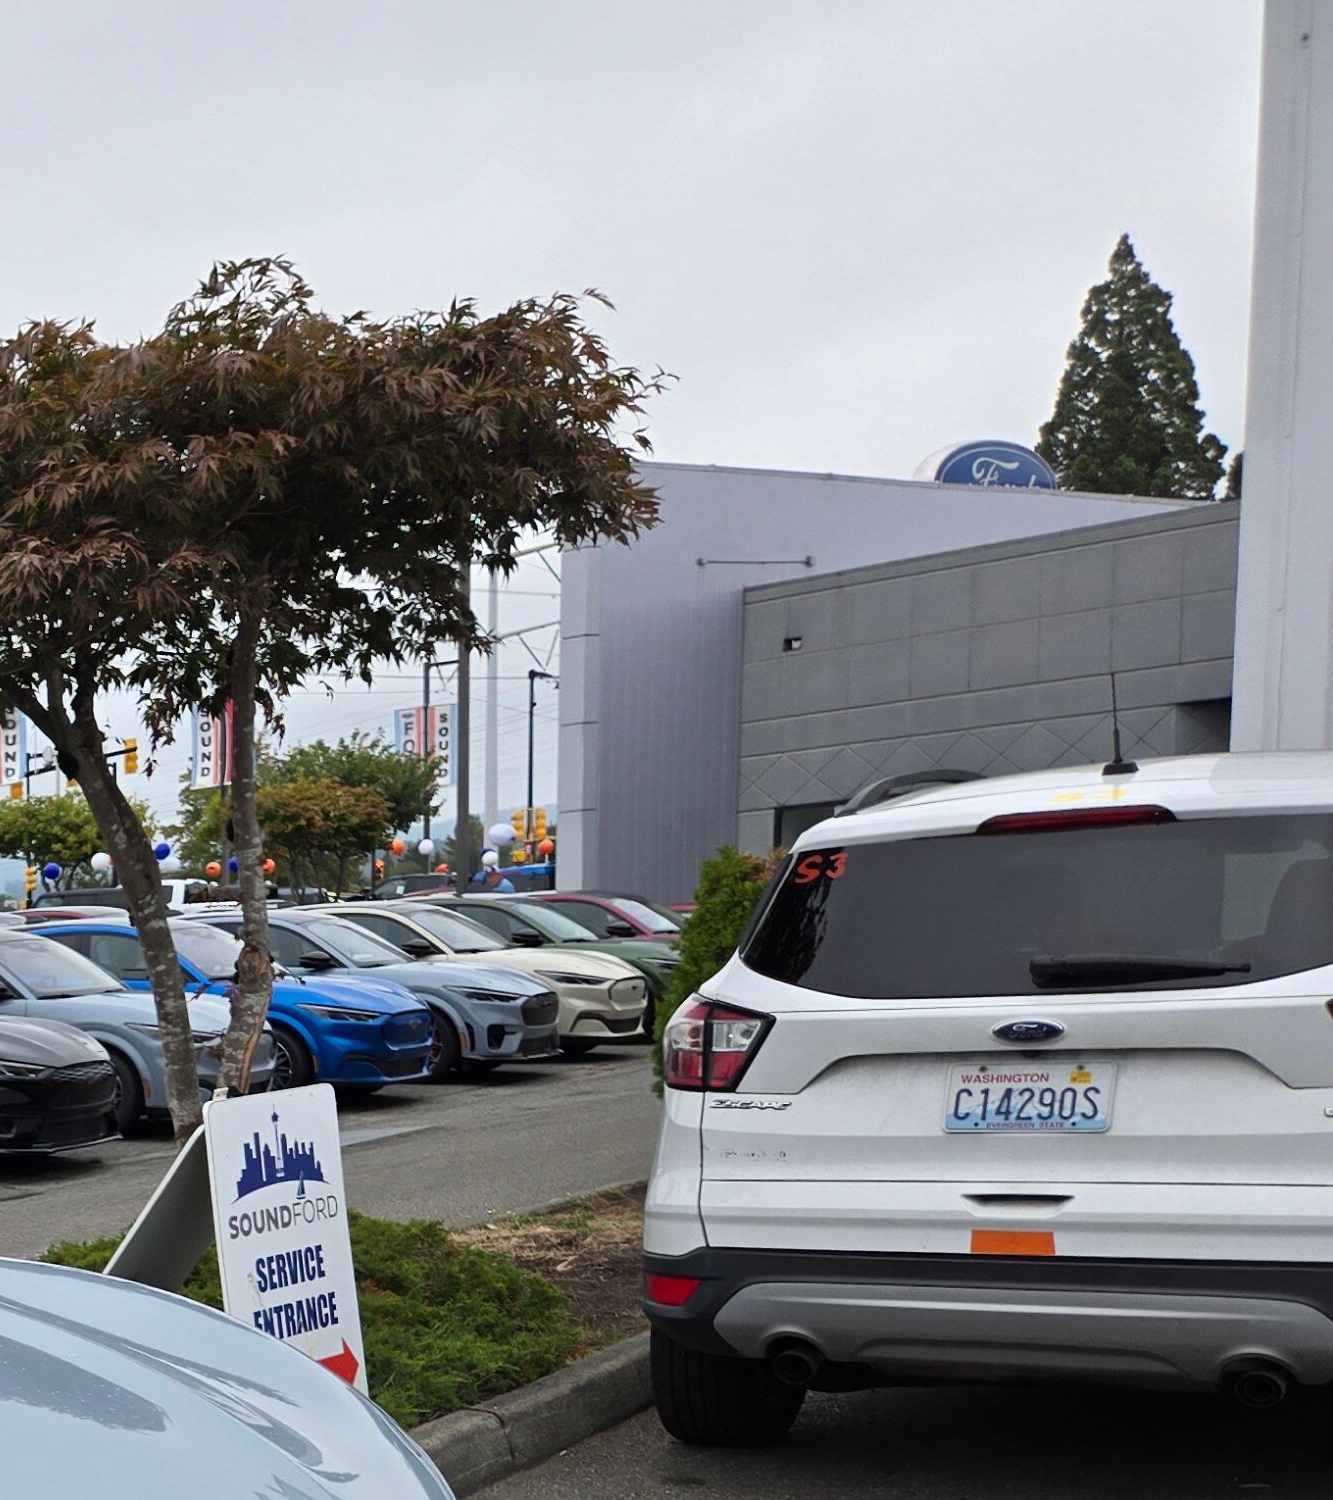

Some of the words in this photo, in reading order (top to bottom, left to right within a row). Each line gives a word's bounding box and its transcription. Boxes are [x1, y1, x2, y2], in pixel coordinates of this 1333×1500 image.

[403, 721, 415, 754] FO
[794, 851, 849, 885] S3
[960, 1072, 1050, 1084] WASHINGTON
[953, 1086, 1101, 1122] C14290S
[255, 1244, 326, 1293] SERVICE
[252, 1291, 339, 1340] ENTRANCE
